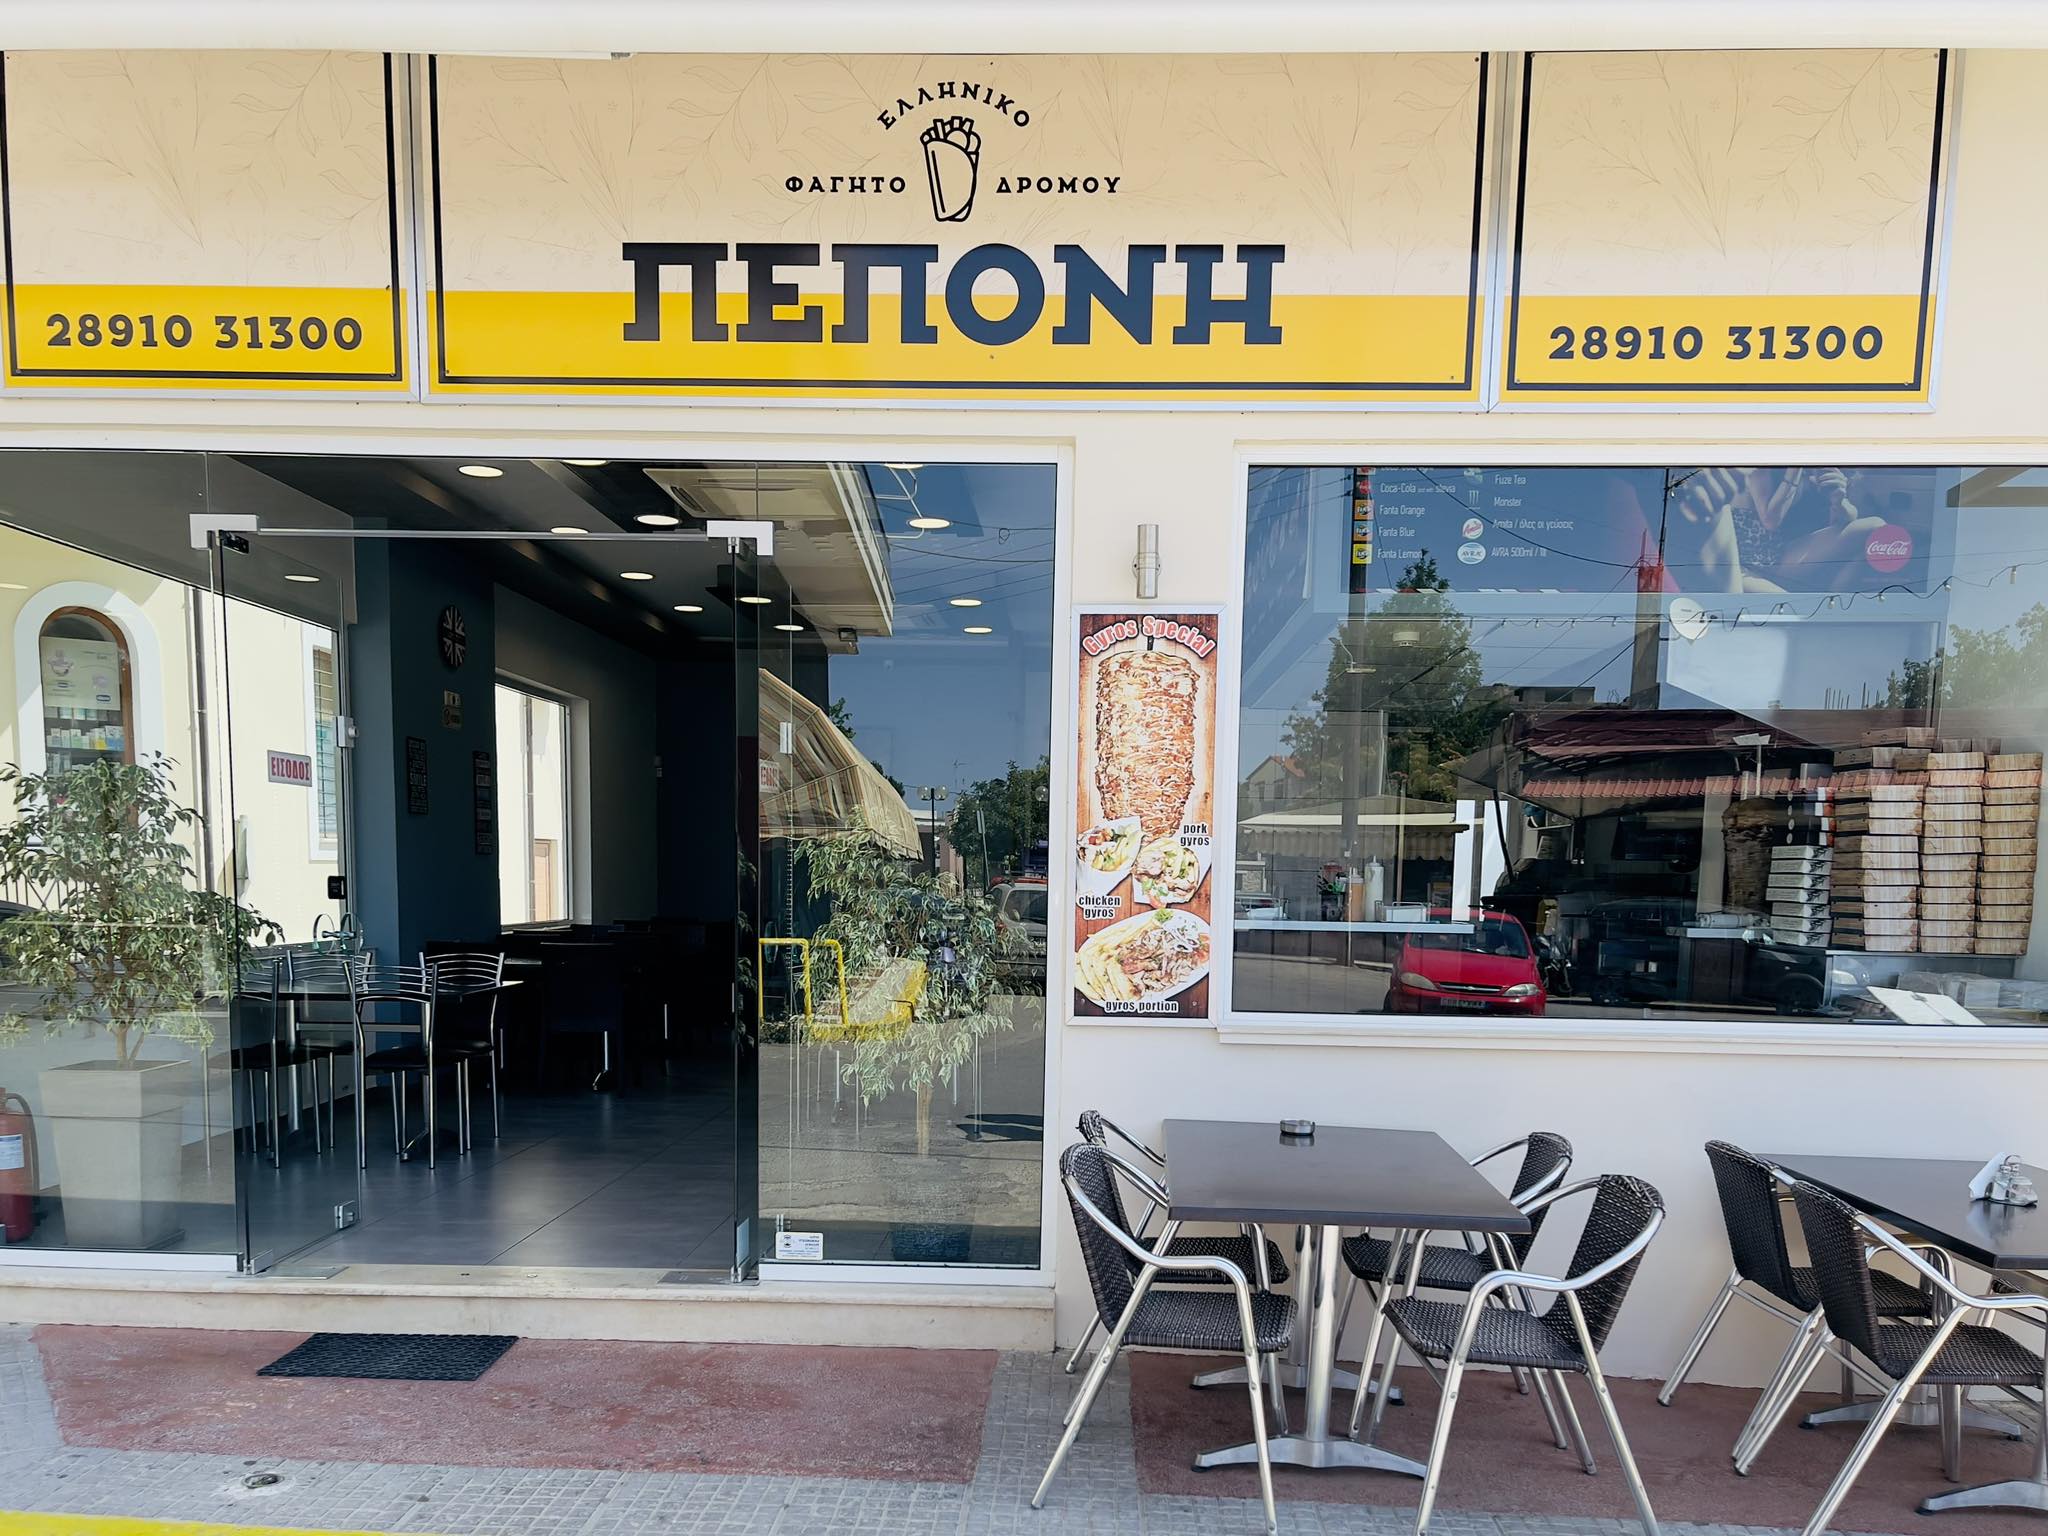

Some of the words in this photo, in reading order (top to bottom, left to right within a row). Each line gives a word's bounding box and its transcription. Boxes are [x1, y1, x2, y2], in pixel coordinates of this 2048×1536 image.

[876, 81, 1030, 130] ΕΛΛΗΝΙΚΟ
[785, 175, 906, 193] ΦΑΓΗΤΟ
[995, 176, 1121, 193] ΔΡΟΜΟΥ
[622, 243, 1286, 345] ΠΕΠΟΝΗ
[46, 313, 192, 348] 28910
[214, 315, 363, 350] 31300
[1548, 325, 1704, 360] 28910
[1725, 325, 1884, 360] 31300
[1494, 474, 1512, 485] Fuze
[1513, 474, 1527, 485] Tea
[1380, 482, 1416, 493] Coca-Cola
[1493, 497, 1522, 507] Monster
[1379, 504, 1399, 515] Fanta
[1400, 504, 1426, 517] Orange
[1378, 526, 1398, 536] Fanta
[1399, 526, 1415, 537] Blue
[1377, 548, 1397, 559] Fanta
[1398, 548, 1423, 559] Lemon
[1490, 547, 1511, 558] AVRA
[1511, 547, 1533, 557] 500ml
[1083, 619, 1139, 656] Gyros
[1142, 615, 1216, 658] Special
[271, 756, 310, 781] ΕΙΣΟΔΟΣ
[1183, 823, 1208, 834] pork
[1180, 836, 1210, 847] gyros
[1078, 895, 1121, 906] chicken
[1084, 908, 1115, 919] gyros
[1105, 1001, 1135, 1012] gyros
[1139, 1001, 1178, 1012] portion
